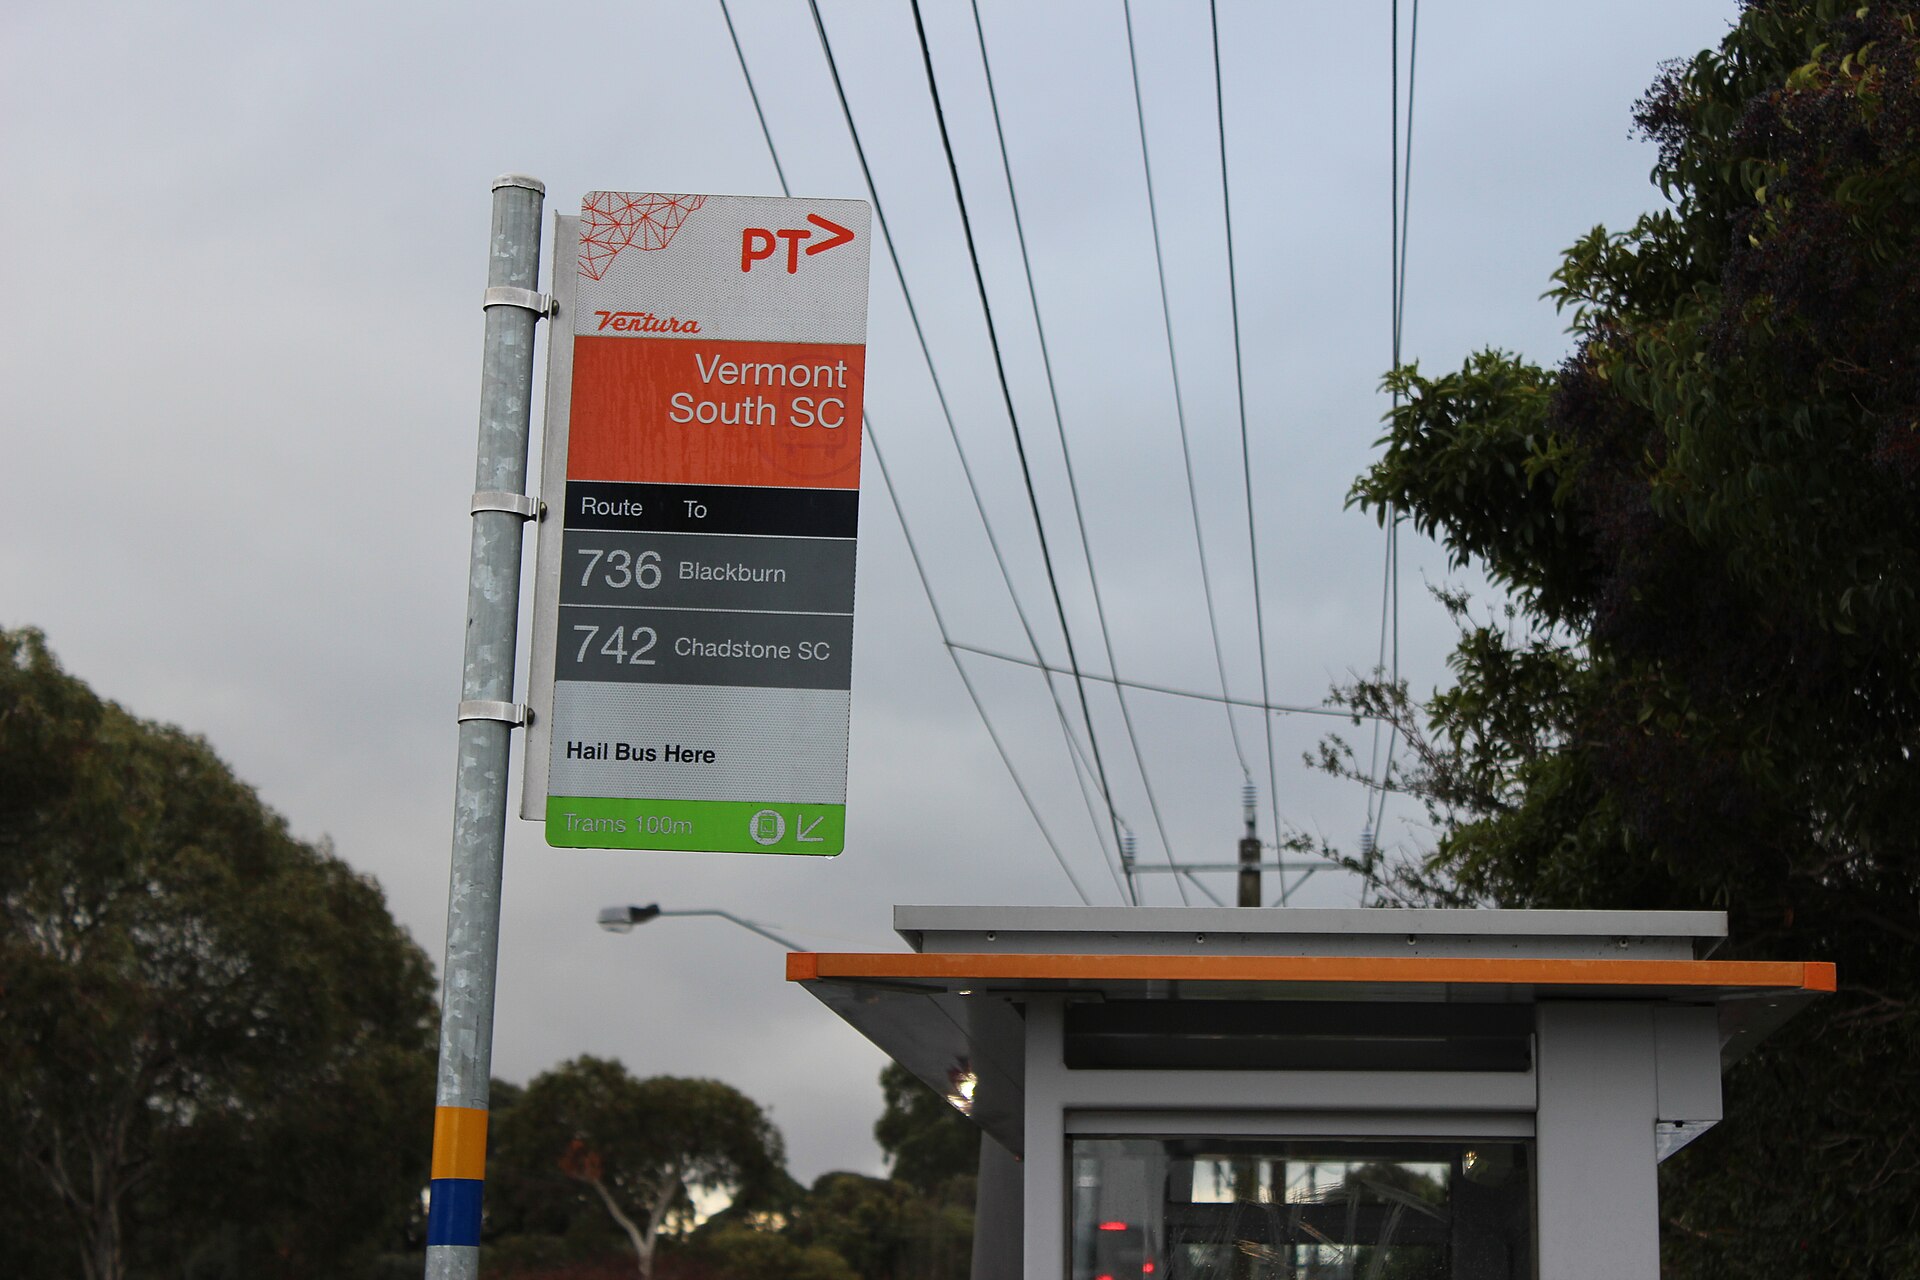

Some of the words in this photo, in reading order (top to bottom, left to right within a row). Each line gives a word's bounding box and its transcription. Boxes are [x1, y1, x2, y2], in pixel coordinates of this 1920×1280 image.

[595, 311, 701, 334] Ventura
[695, 353, 848, 389] Vermont
[669, 392, 776, 426] South
[789, 396, 845, 429] SC
[581, 497, 643, 517] Route
[683, 500, 708, 519] To
[577, 549, 662, 589] 736
[679, 561, 786, 583] Blackburn
[573, 624, 657, 665] 742
[674, 637, 791, 660] Chadstone
[797, 641, 830, 661] SC
[566, 741, 608, 760] Hail
[615, 743, 657, 762] Bus
[664, 744, 716, 763] Here
[563, 812, 626, 834] Trams
[635, 815, 693, 835] 100m
